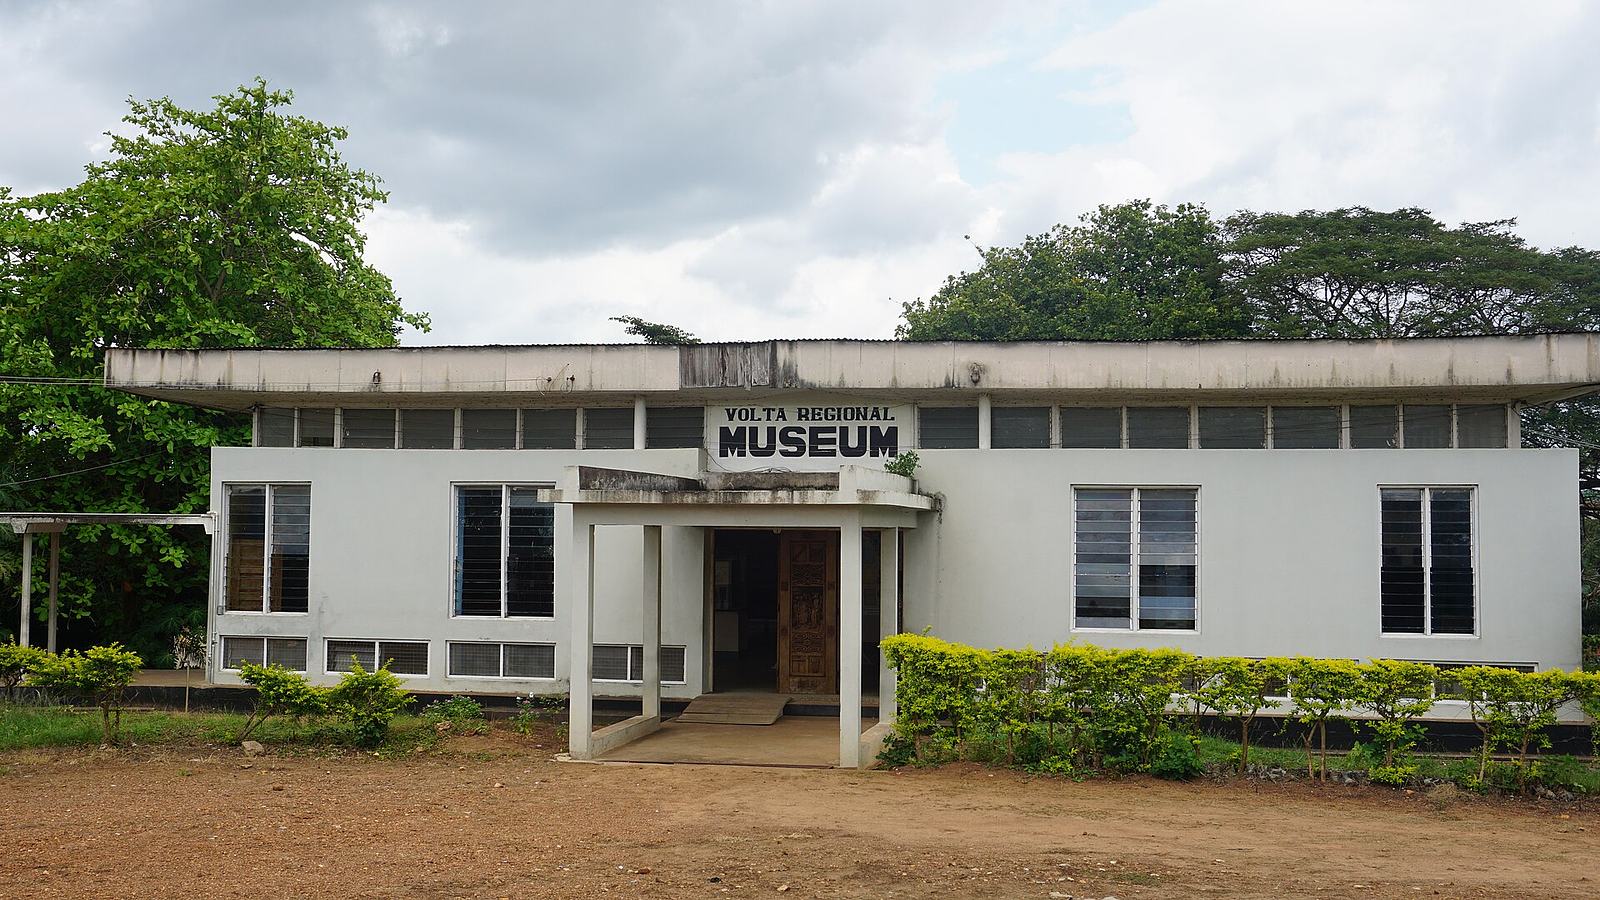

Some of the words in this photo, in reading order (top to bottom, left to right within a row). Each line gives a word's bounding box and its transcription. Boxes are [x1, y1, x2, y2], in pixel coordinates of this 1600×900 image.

[725, 407, 788, 422] VOLTA
[796, 406, 895, 422] REGIONAL
[719, 426, 899, 458] MUSEUM
